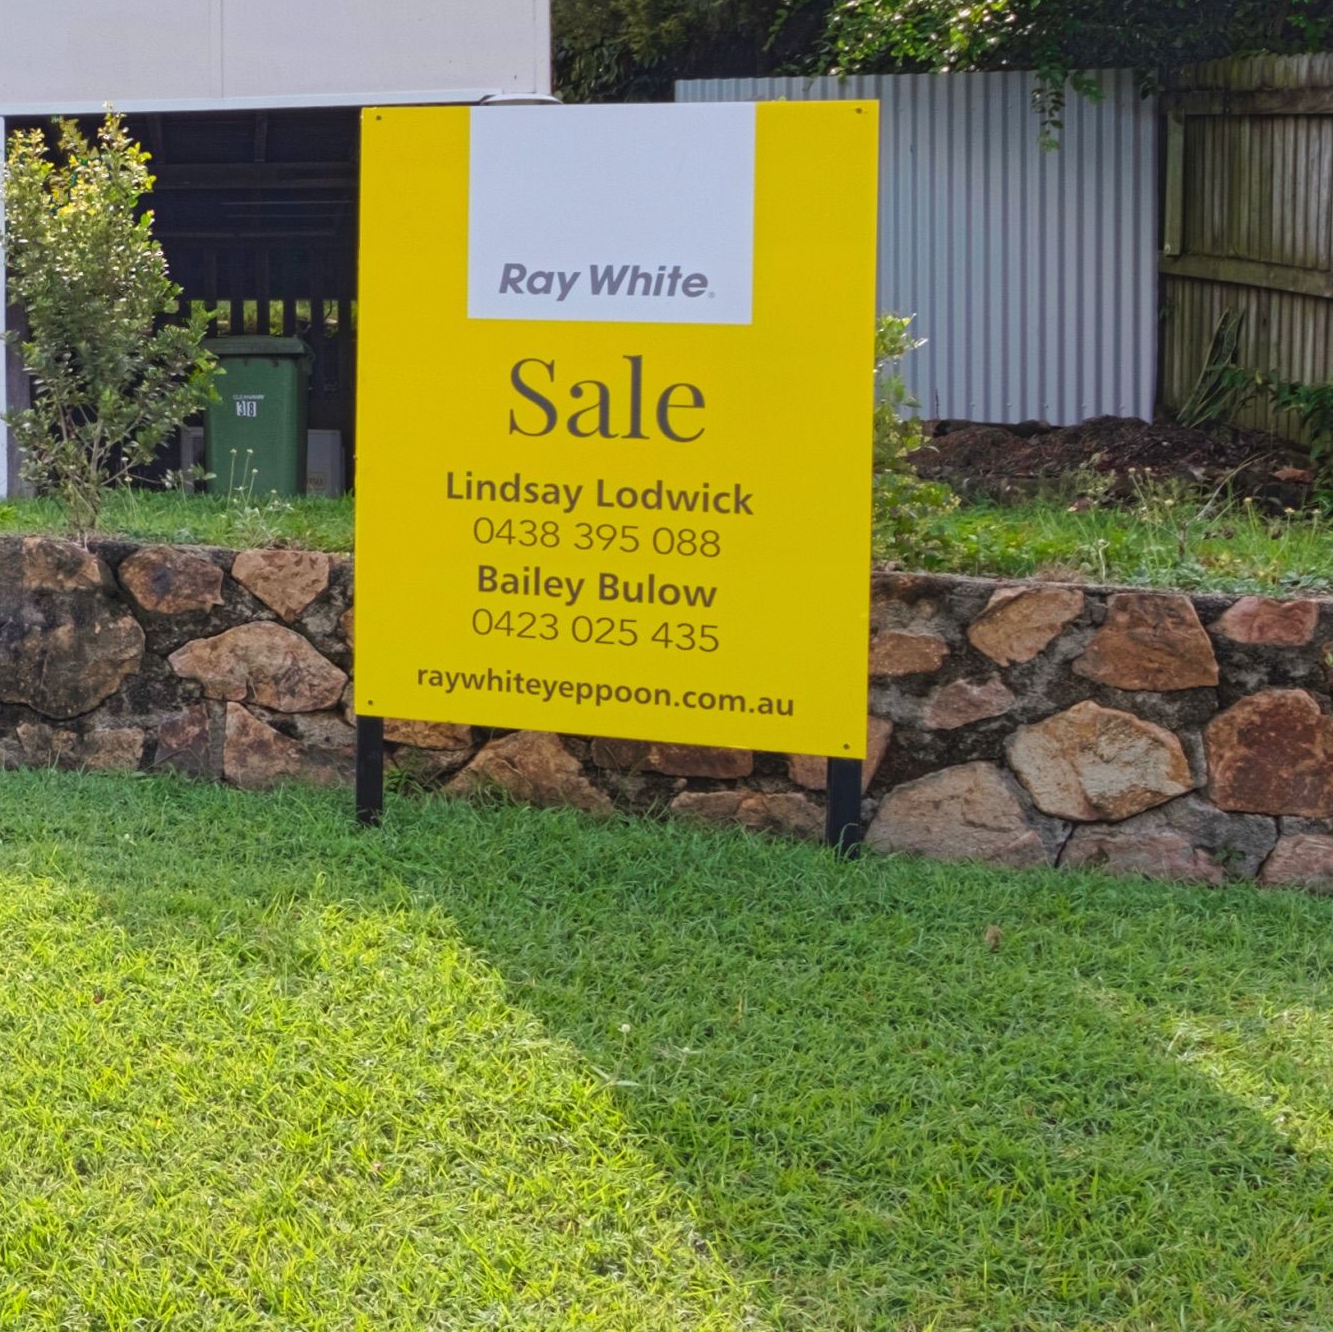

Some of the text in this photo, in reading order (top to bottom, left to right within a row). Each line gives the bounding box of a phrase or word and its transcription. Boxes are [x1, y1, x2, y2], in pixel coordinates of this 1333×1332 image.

[499, 263, 709, 301] Ray White
[237, 402, 256, 416] 38
[508, 355, 706, 443] Sale
[446, 471, 754, 516] Lindsay Lodwick
[473, 517, 721, 557] 0438 395 088
[475, 565, 718, 609] Bailey Bulow
[471, 608, 720, 653] 0423 025 435
[417, 667, 795, 718] raywhiteyeppoon.com.au
